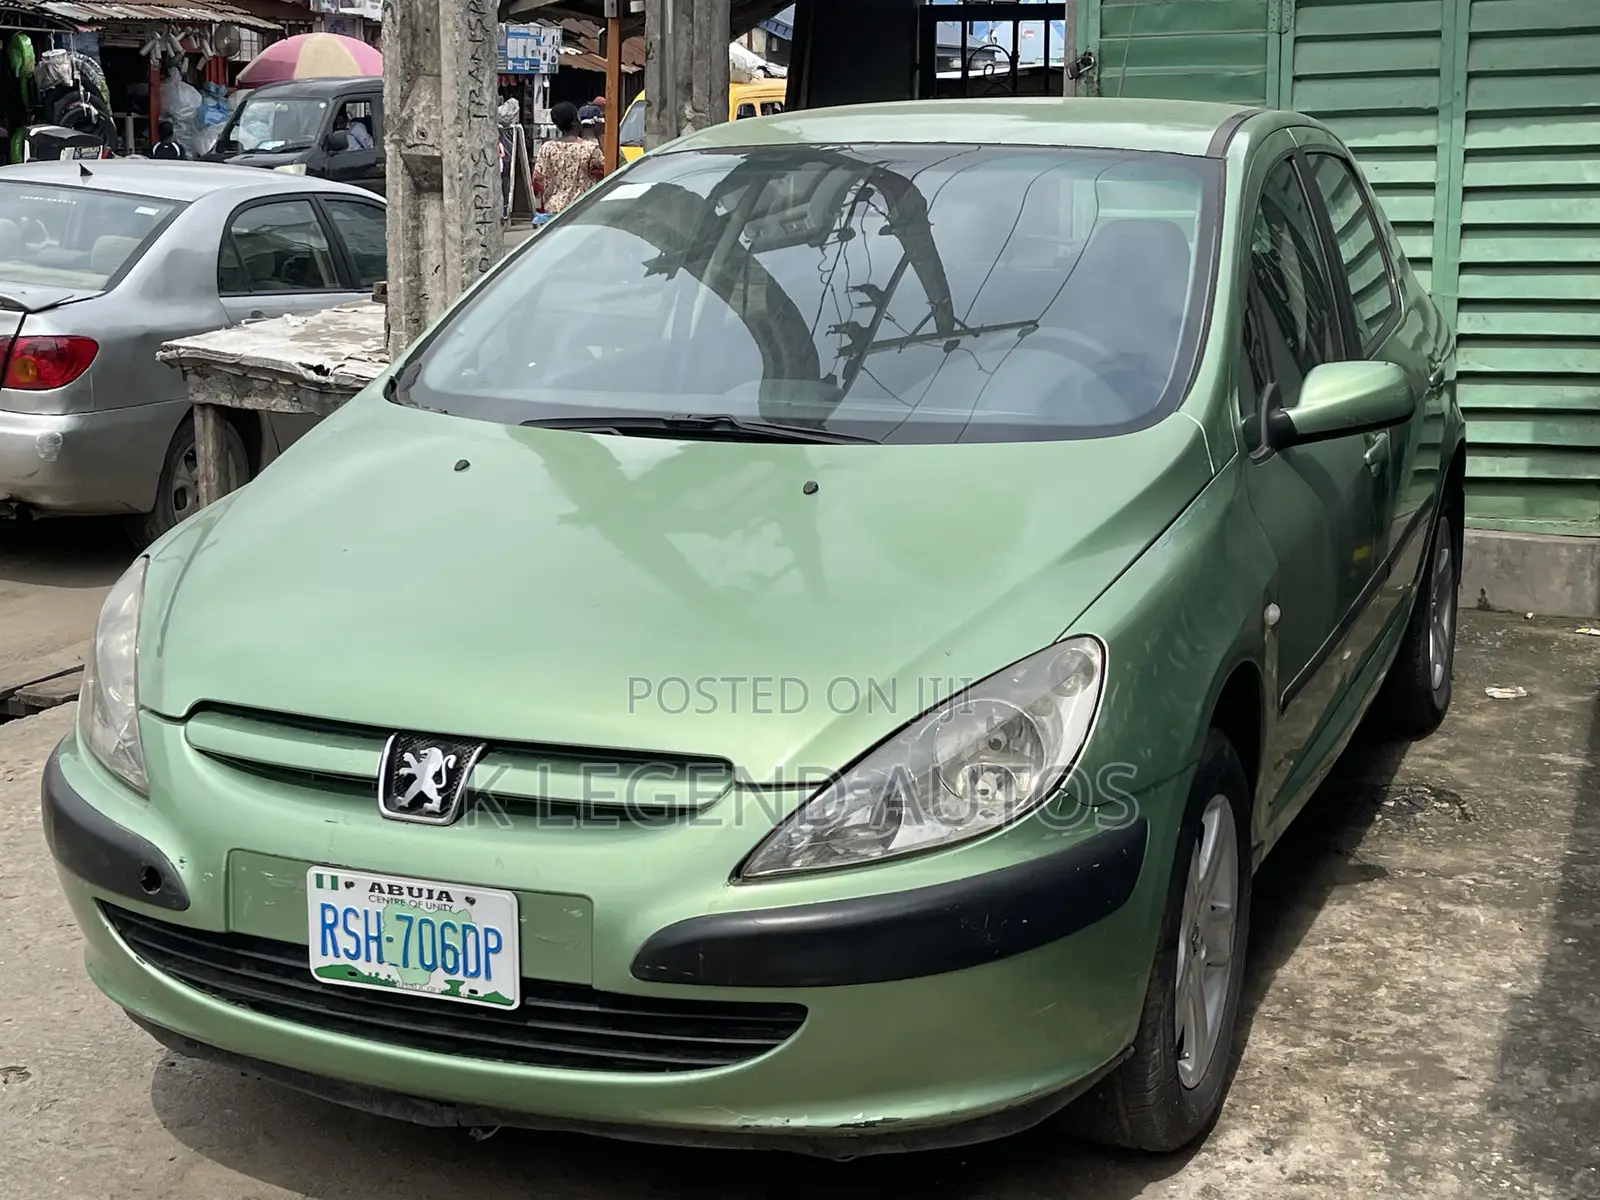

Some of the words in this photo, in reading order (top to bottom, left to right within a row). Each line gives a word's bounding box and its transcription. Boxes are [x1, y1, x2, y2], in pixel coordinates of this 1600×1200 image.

[368, 882, 455, 903] ABUJA
[368, 894, 407, 907] CENTRE
[408, 899, 423, 909] OF
[425, 901, 454, 912] UNITY
[320, 902, 503, 981] RSH-706DP
